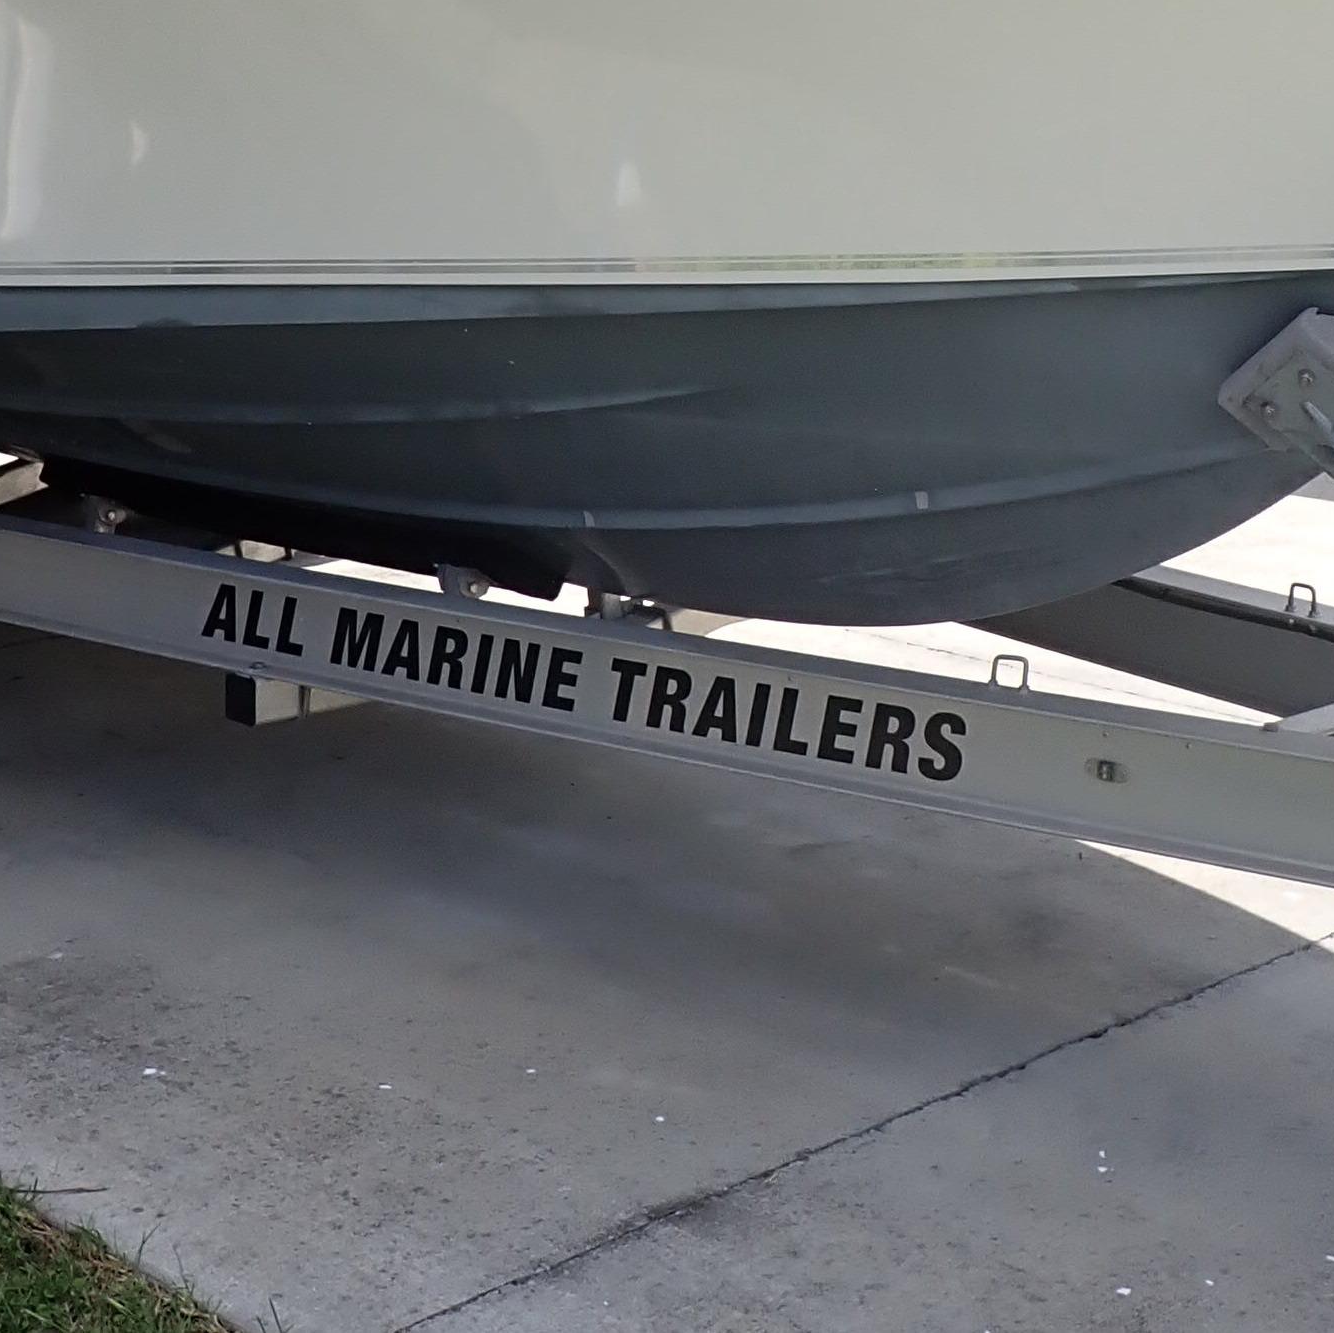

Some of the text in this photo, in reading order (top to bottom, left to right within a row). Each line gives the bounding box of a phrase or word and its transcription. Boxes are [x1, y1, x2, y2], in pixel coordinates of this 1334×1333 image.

[201, 583, 967, 782] ALL MARINE TRAILERS
